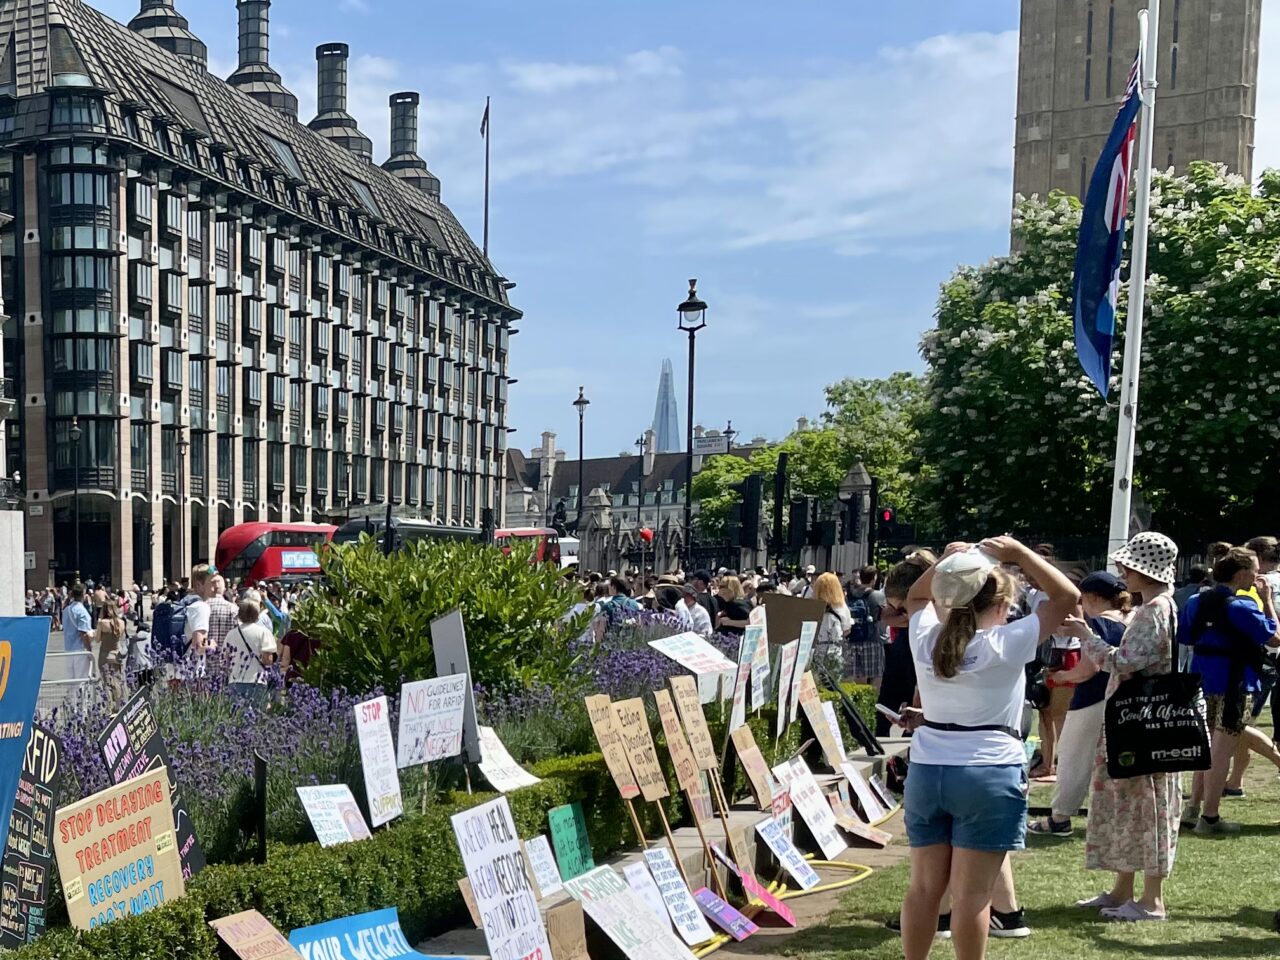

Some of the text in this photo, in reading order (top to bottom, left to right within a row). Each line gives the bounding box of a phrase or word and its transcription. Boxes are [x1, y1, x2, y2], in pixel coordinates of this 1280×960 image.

[362, 701, 381, 723] STOP
[406, 680, 464, 714] NO GUIDELINES
[428, 698, 441, 711] FOR
[1118, 704, 1194, 725] South Africa
[1151, 693, 1169, 702] BEST
[616, 707, 642, 732] Eating
[1151, 745, 1202, 761] m-eat!
[59, 808, 93, 844] STOP
[96, 780, 164, 827] DELAYING
[486, 804, 514, 844] HEAL
[75, 816, 153, 874] TREATMENT
[88, 855, 155, 907] RECOVERY
[493, 850, 533, 895] RECOVER
[130, 880, 164, 916] WAIT
[484, 905, 501, 940] BUT
[500, 896, 519, 934] NOT
